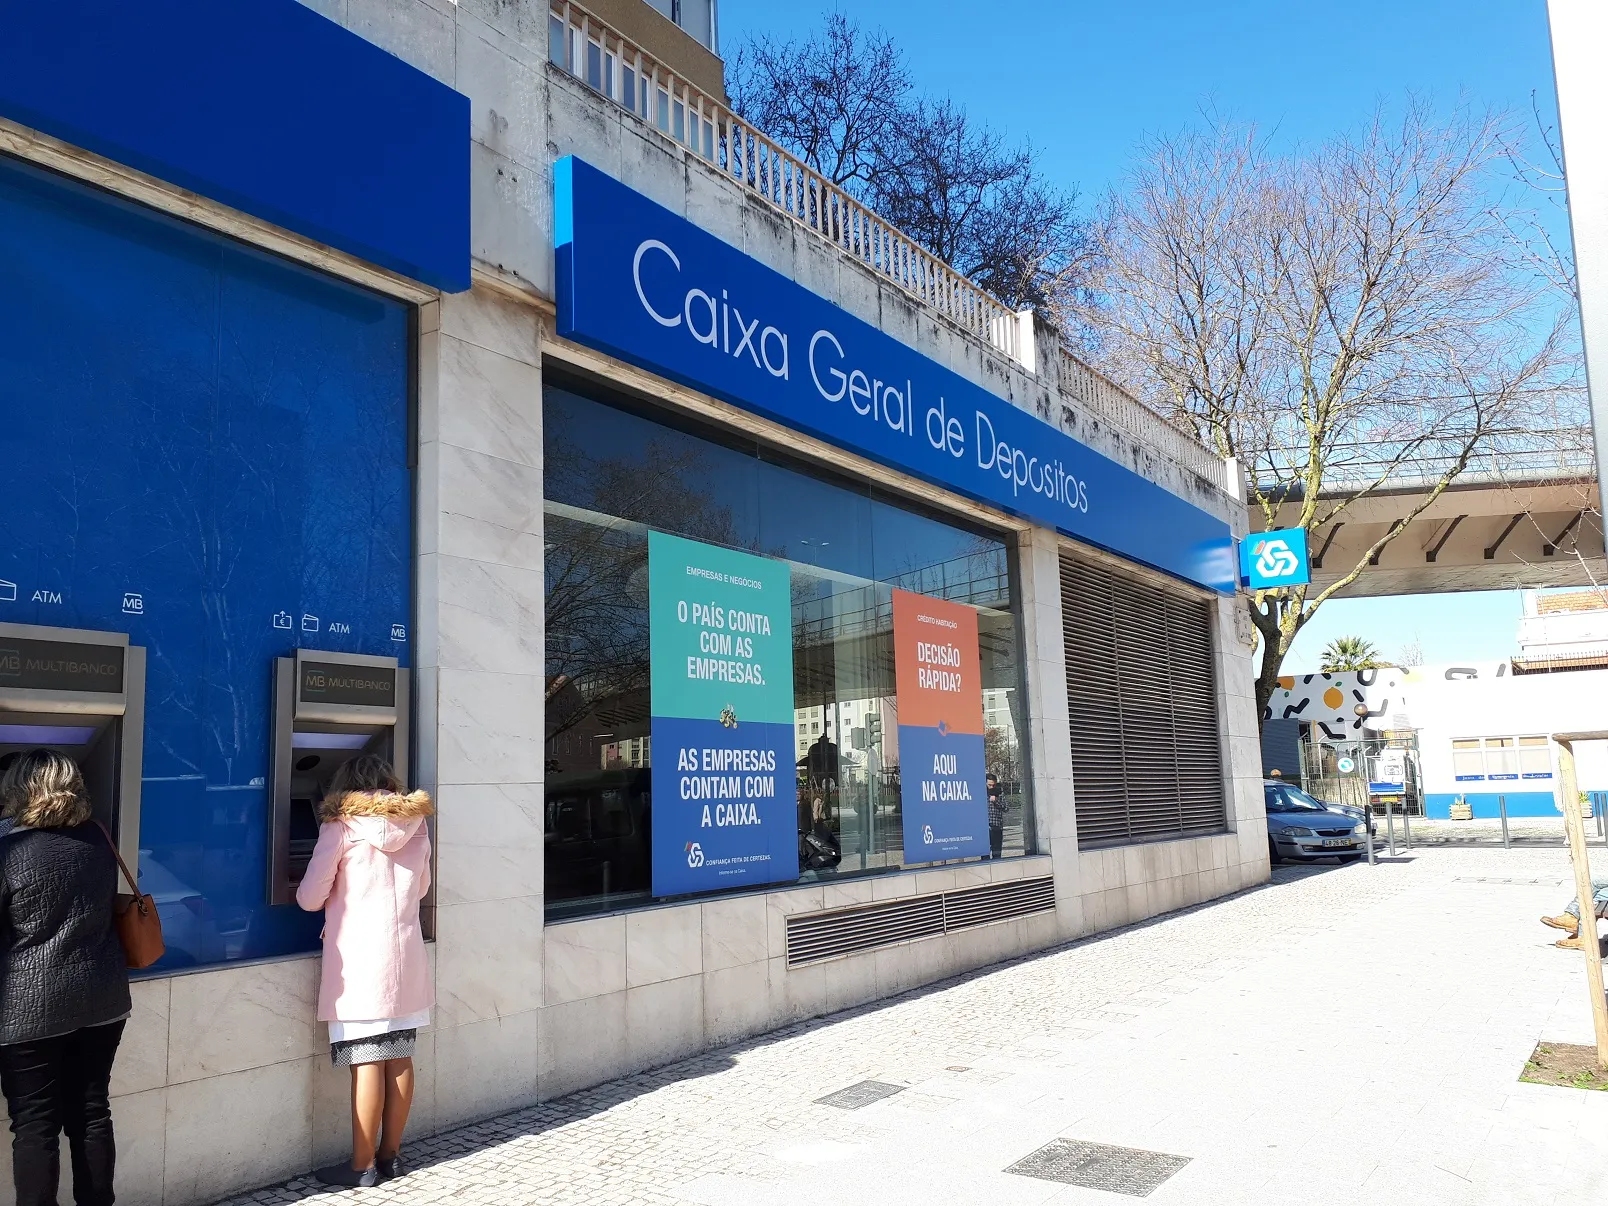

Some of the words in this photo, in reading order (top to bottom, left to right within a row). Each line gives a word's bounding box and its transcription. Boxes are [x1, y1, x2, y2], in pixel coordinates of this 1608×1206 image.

[632, 239, 790, 380] Caixa
[809, 330, 913, 436] Geral
[926, 397, 964, 458] de
[975, 410, 1088, 514] Depositos
[686, 566, 722, 581] EMPRESAS
[730, 575, 761, 589] NEGÓCIOS
[32, 590, 62, 604] ATM
[123, 598, 143, 609] MB
[329, 623, 350, 633] ATM
[678, 601, 688, 622] O
[693, 602, 724, 628] PAÍS
[728, 610, 771, 636] CONTA
[917, 614, 935, 624] CRÉDITO
[391, 628, 405, 637] MB
[700, 631, 731, 656] COM
[735, 637, 752, 658] AS
[918, 642, 960, 667] DECISÃO
[26, 659, 117, 675] MULTIBANCO
[688, 656, 765, 685] EMPRESAS.
[919, 665, 961, 692] RÁPIDA?
[306, 675, 325, 687] MB
[328, 678, 391, 691] MULTIBANCO
[678, 748, 698, 771] AS
[703, 749, 775, 771] EMPRESAS
[934, 754, 956, 775] AQUI
[681, 777, 740, 800] CONTAM
[745, 776, 774, 798] COM
[922, 781, 937, 801] NA
[940, 781, 972, 801] CAIXA.
[701, 805, 712, 827] A
[716, 803, 761, 826] CAIXA.
